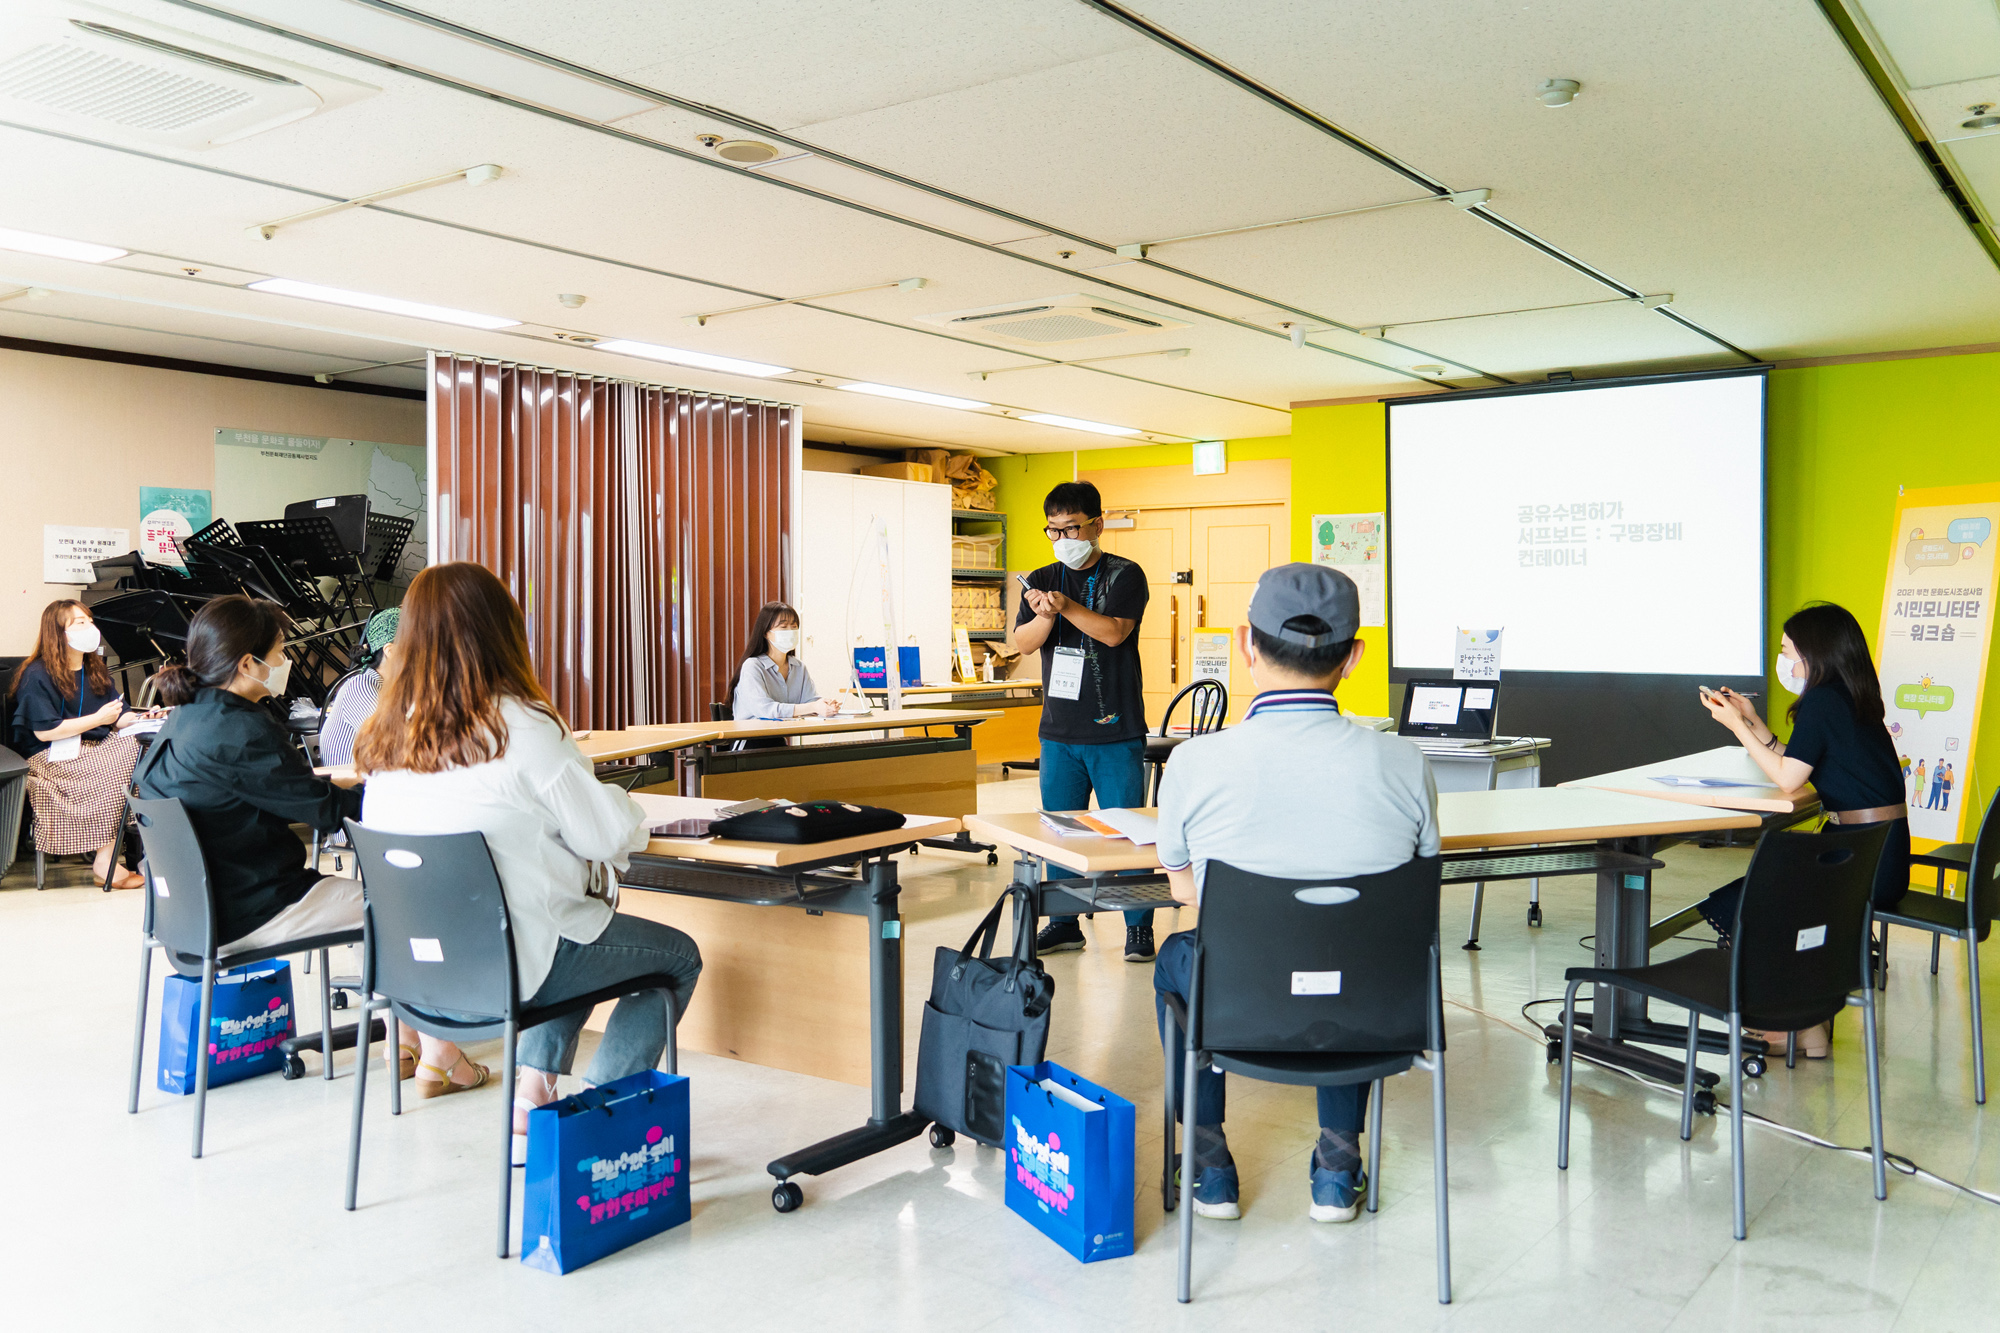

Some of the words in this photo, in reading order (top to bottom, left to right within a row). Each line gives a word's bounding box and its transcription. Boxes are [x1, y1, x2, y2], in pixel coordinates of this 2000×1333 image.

[235, 433, 259, 443] 부천을
[261, 435, 285, 446] 문화로
[1517, 500, 1624, 523] 공유수면허가
[1517, 525, 1587, 545] 서프보드
[1595, 527, 1601, 540] :
[1609, 522, 1683, 543] 구명장비
[1517, 547, 1588, 568] 컨테이너
[1896, 588, 1915, 597] 2021
[1916, 588, 1929, 597] 부천
[1930, 587, 1983, 597] 문화도시조성사업
[1893, 600, 1981, 618] 시민모니터단
[1910, 623, 1956, 641] 워크숍
[1903, 694, 1917, 703] 현장
[1917, 694, 1946, 705] 모니터링
